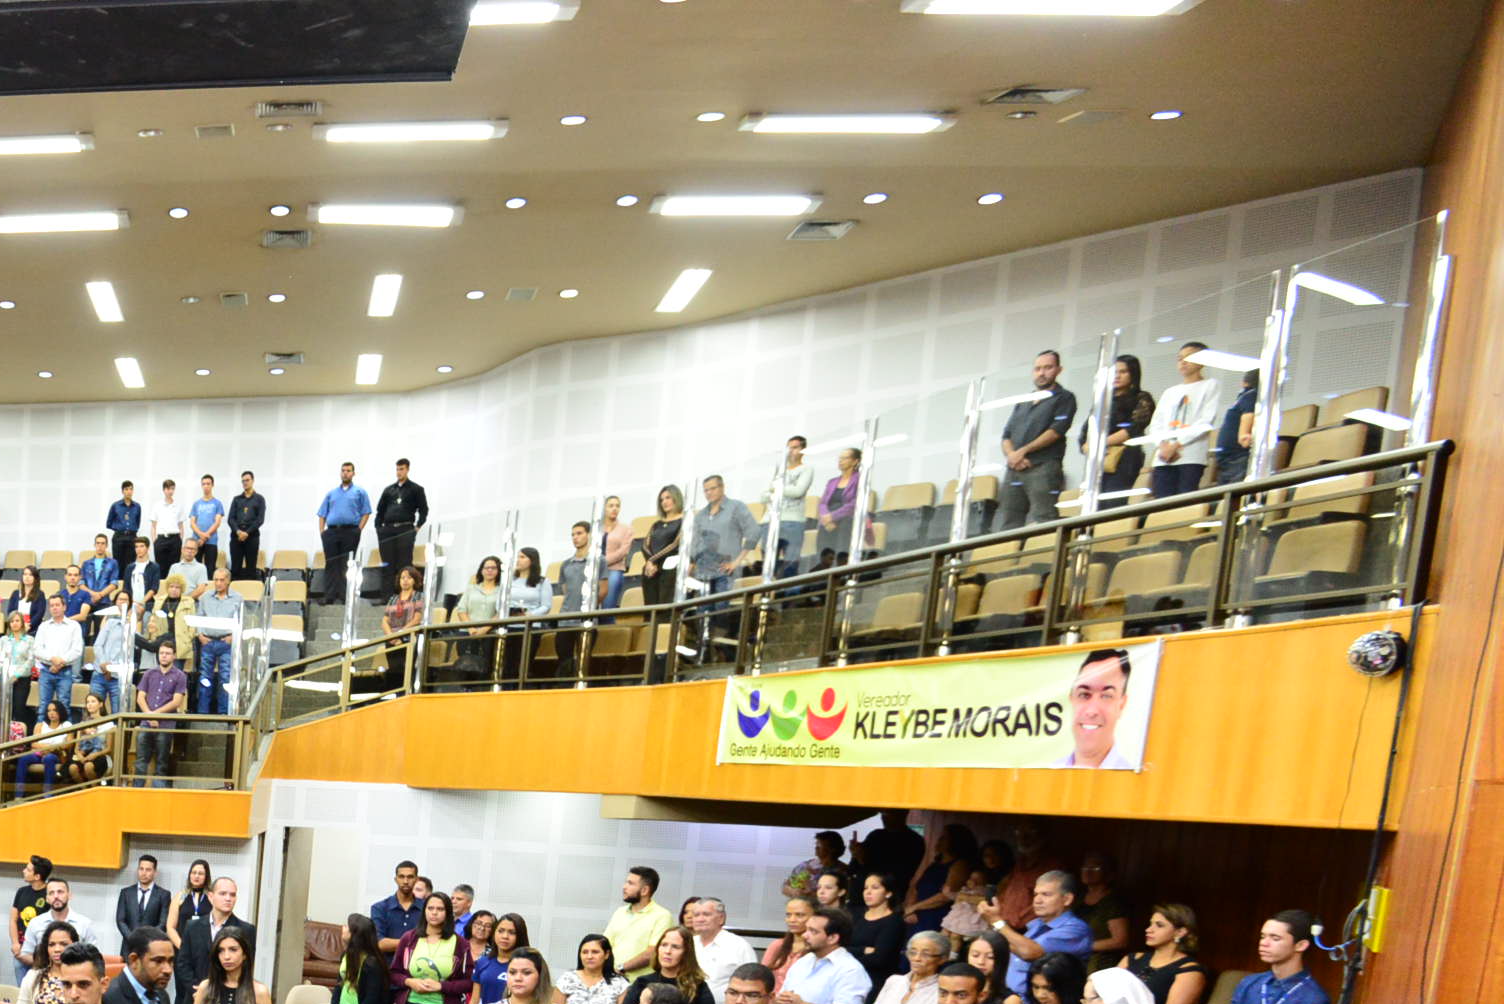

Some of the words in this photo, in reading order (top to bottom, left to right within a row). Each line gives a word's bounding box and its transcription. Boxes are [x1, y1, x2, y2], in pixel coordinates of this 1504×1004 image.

[857, 691, 911, 708] Vereador
[853, 707, 947, 739] KLEYBE
[948, 702, 1063, 738] MORAIS
[730, 743, 757, 757] Gente
[760, 744, 806, 759] Ajudando
[809, 743, 840, 758] Gente
